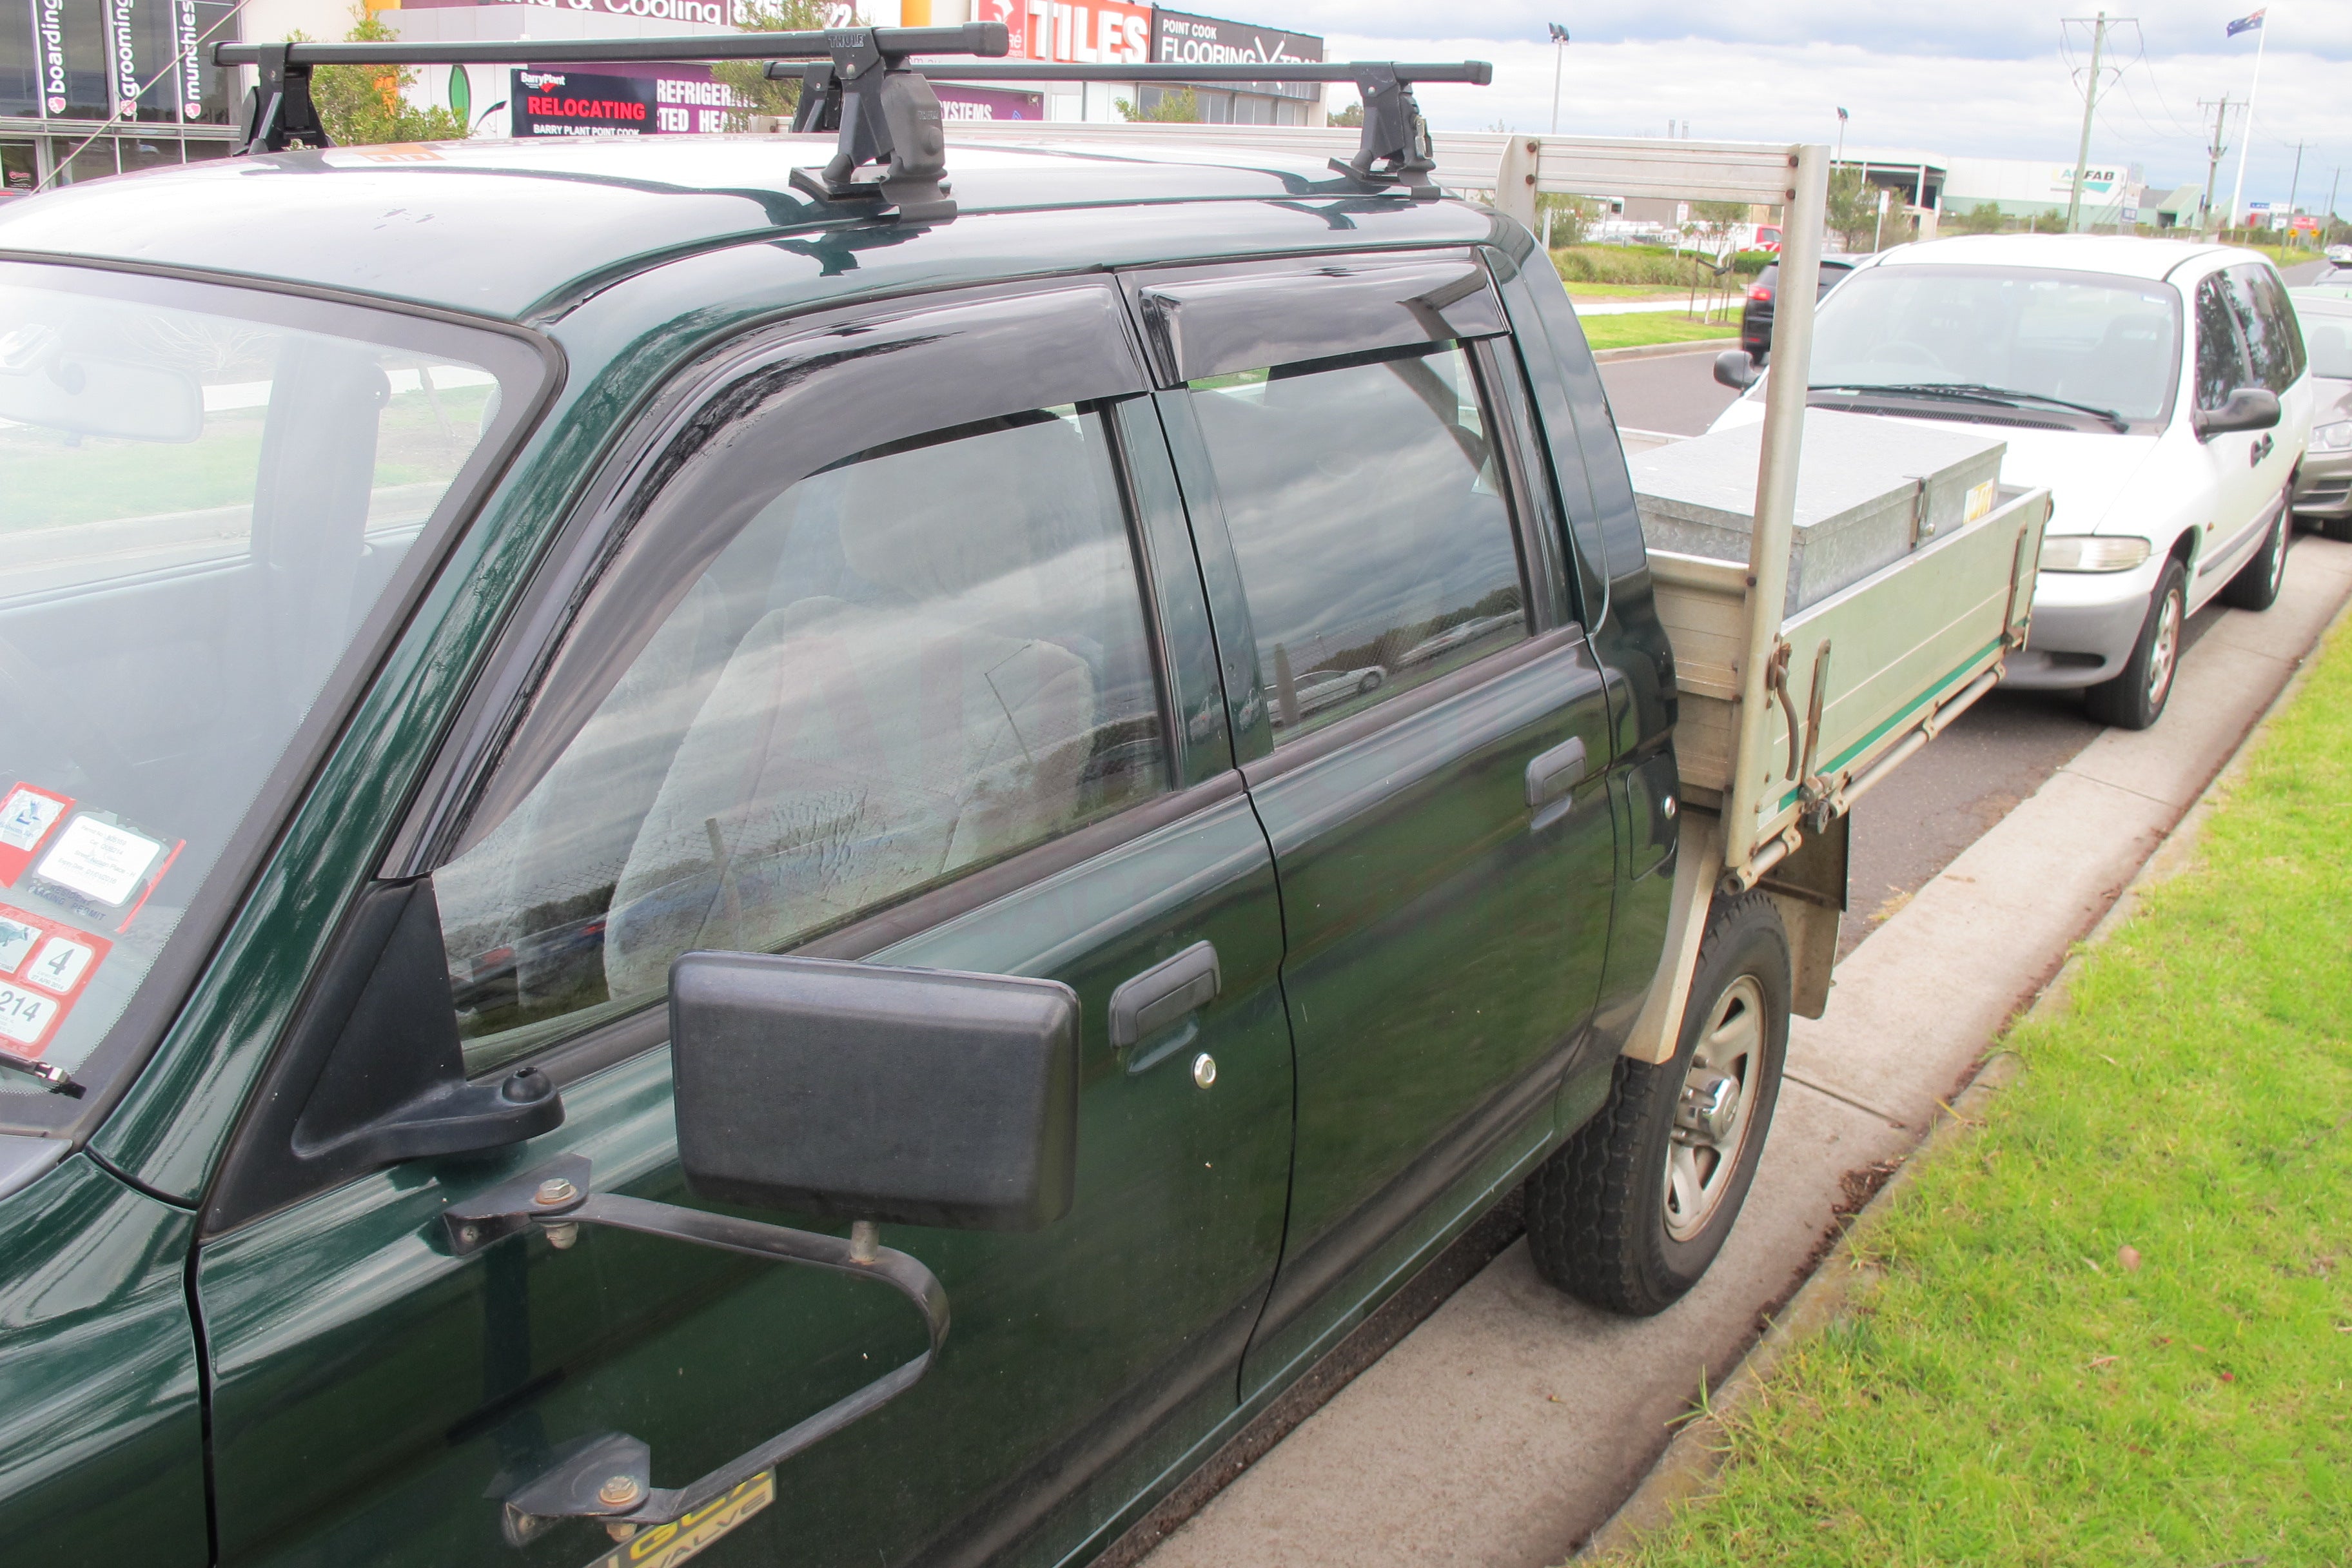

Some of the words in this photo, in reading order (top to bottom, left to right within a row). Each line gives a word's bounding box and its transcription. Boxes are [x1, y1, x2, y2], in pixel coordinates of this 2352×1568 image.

[828, 34, 864, 48] THULE
[1029, 1, 1148, 64] TILES
[1162, 19, 1190, 35] POINT
[1191, 23, 1217, 40] COOK
[179, 1, 202, 100] munchies
[1161, 36, 1257, 63] FLOORING
[527, 96, 646, 121] RELOCATING
[533, 124, 563, 134] BARRY
[564, 126, 591, 135] PLANT
[592, 127, 614, 136] POINT
[71, 902, 106, 921] PERMIT
[48, 948, 75, 976] 4
[0, 990, 42, 1022] 214
